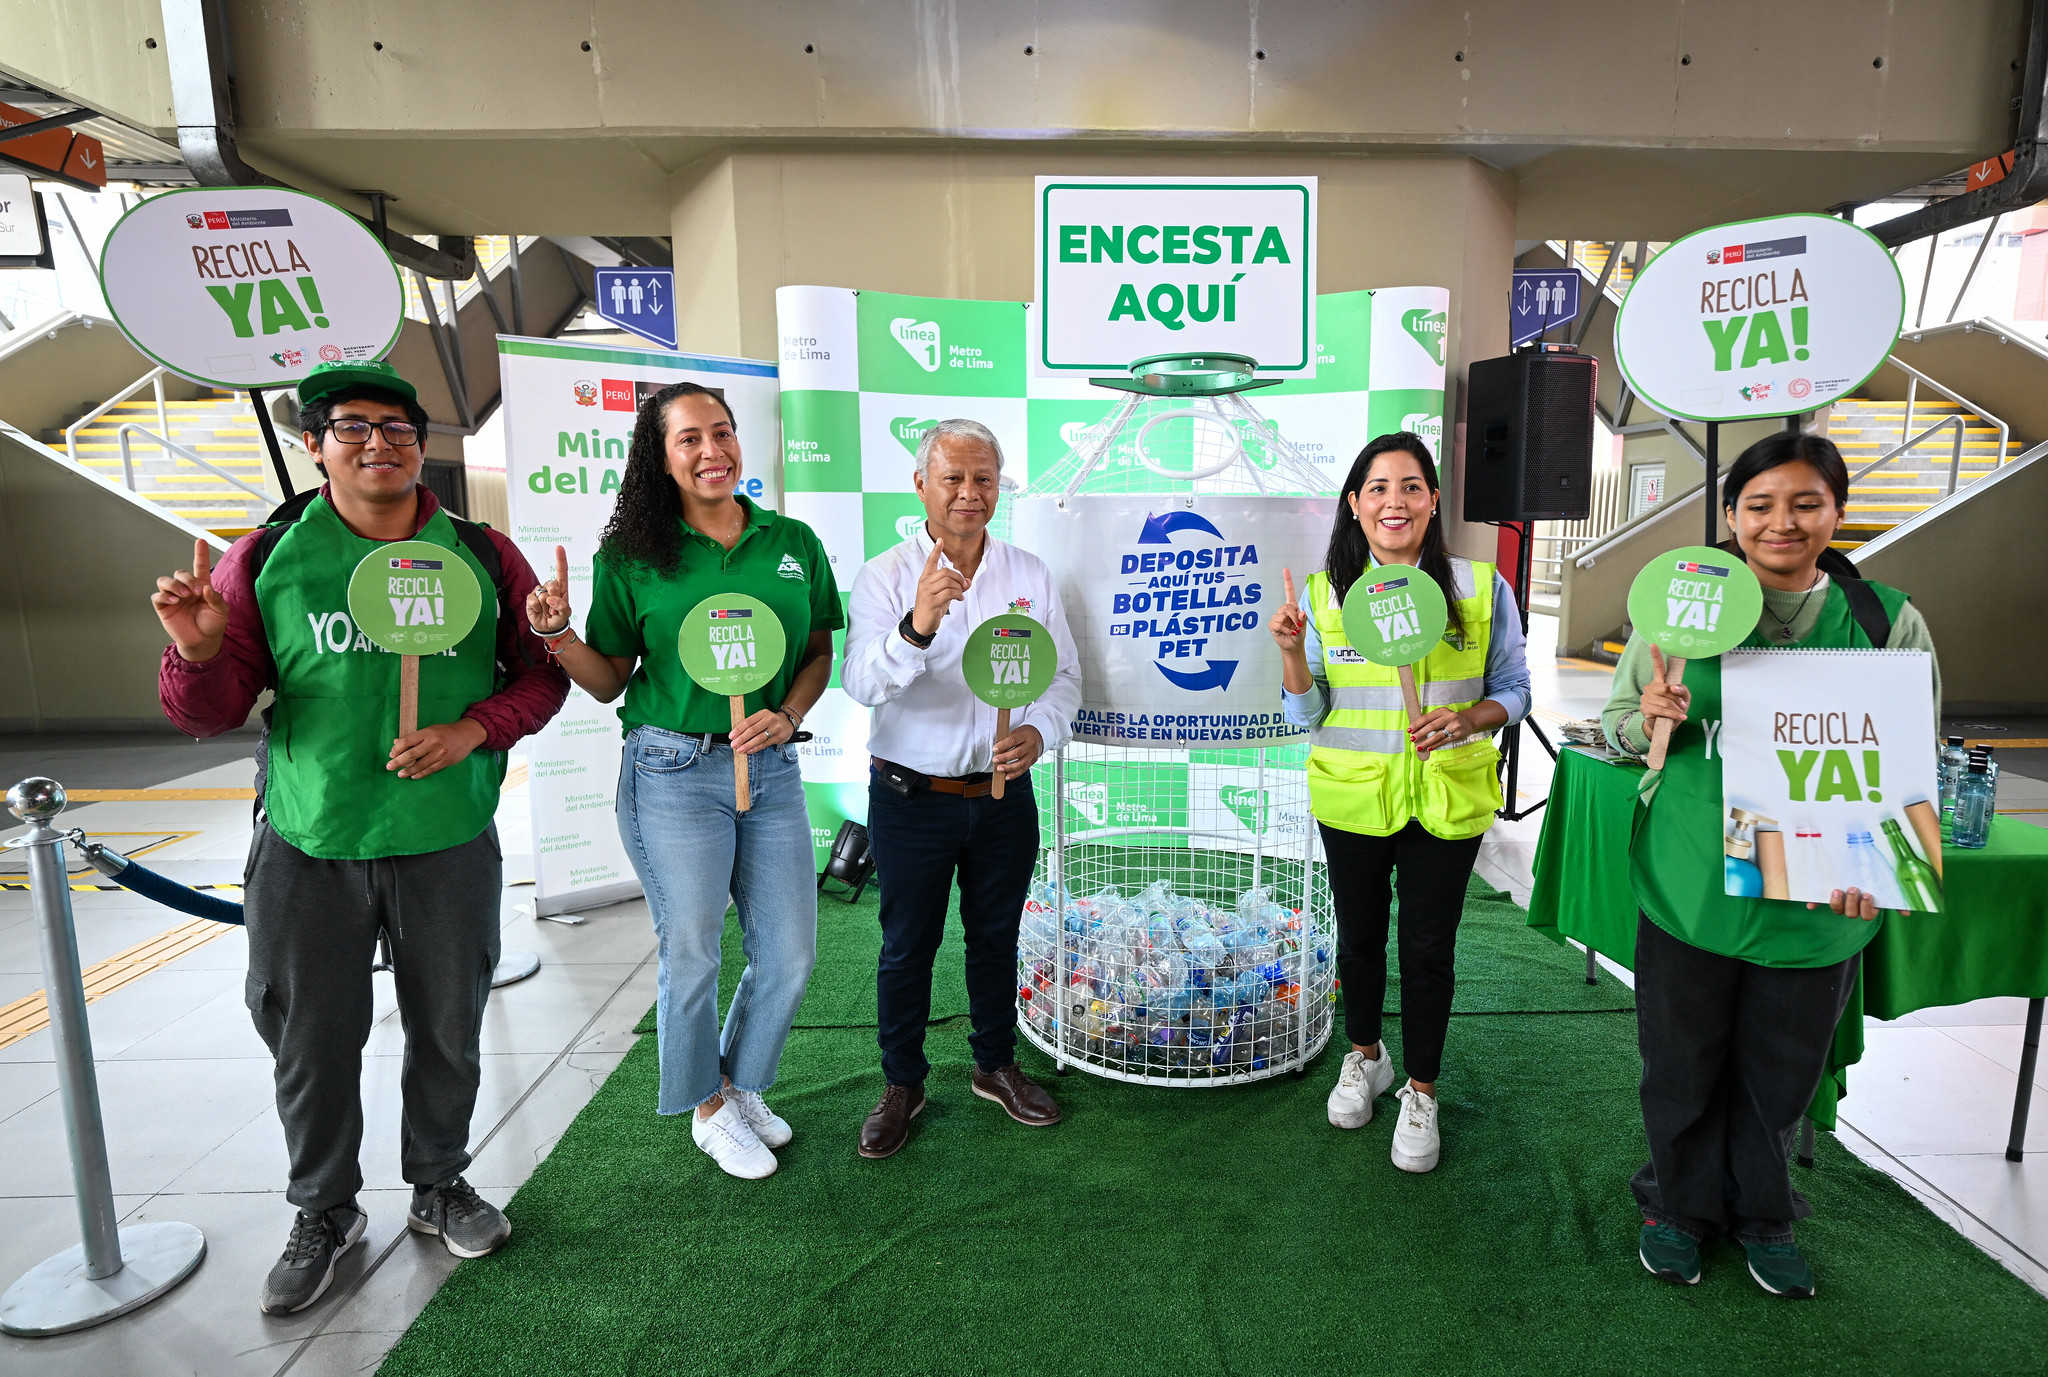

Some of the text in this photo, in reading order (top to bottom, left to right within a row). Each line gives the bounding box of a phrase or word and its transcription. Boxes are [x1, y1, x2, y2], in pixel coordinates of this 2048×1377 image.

[1059, 225, 1291, 264] ENCESTA
[192, 239, 311, 278] RECICLA
[1725, 250, 1742, 258] PERÚ
[1755, 250, 1780, 258] Ambiente
[1701, 268, 1808, 313] RECICLA
[205, 276, 330, 338] YA!
[1107, 272, 1247, 331] AQUÍ
[784, 336, 817, 346] Metro
[1702, 306, 1809, 371] YA!
[785, 348, 831, 360] de Lima
[925, 344, 935, 366] 1
[949, 345, 982, 356] Metro
[1438, 336, 1445, 361] 1
[949, 357, 993, 369] de Lima
[606, 390, 631, 401] PERÚ
[787, 439, 818, 450] Metro
[1434, 438, 1440, 461] 1
[788, 451, 831, 462] de Lima
[528, 465, 588, 494] del
[518, 525, 560, 533] Ministerio
[519, 534, 573, 542] del Ambiente
[1120, 544, 1259, 574] DEPOSITA
[388, 576, 444, 596] RECICLA
[1147, 570, 1225, 589] AQUÍ TUS
[1113, 583, 1262, 614] BOTELLAS
[1667, 578, 1723, 603] RECICLA
[389, 597, 445, 626] YA!
[1369, 593, 1415, 617] RECICLA
[1666, 597, 1721, 633] YA!
[307, 611, 353, 654] YO
[709, 624, 755, 642] RECICLA
[1113, 611, 1259, 638] DE PLÁSTICO
[1373, 609, 1421, 643] YA!
[710, 642, 757, 670] YA!
[990, 643, 1031, 660] RECICLA
[1158, 638, 1208, 659] PET
[990, 660, 1030, 685] YA!
[560, 719, 599, 727] Ministerio
[1077, 709, 1125, 724] DALES
[1129, 714, 1150, 726] LA
[1153, 713, 1270, 727] OPORTUNIDAD
[574, 726, 611, 735] Ambiente
[1070, 721, 1310, 741] VERTIRSE EN NUEVAS BOTELLA
[1773, 711, 1879, 747] RECICLA
[1701, 718, 1722, 759] Y
[800, 745, 843, 756] de Lima
[535, 759, 574, 768] Ministerio
[549, 766, 587, 776] Ambiente
[1775, 749, 1883, 804] YA!
[565, 793, 604, 803] Ministerio
[579, 800, 616, 810] Ambiente
[1116, 802, 1147, 811] Metro
[1094, 802, 1103, 820] 1
[1116, 812, 1157, 822] de Lima
[540, 833, 580, 844] Ministerio
[554, 840, 592, 851] Ambiente
[816, 837, 835, 848] Lim
[570, 865, 608, 876] Ministerio
[584, 872, 620, 883] Ambiente
